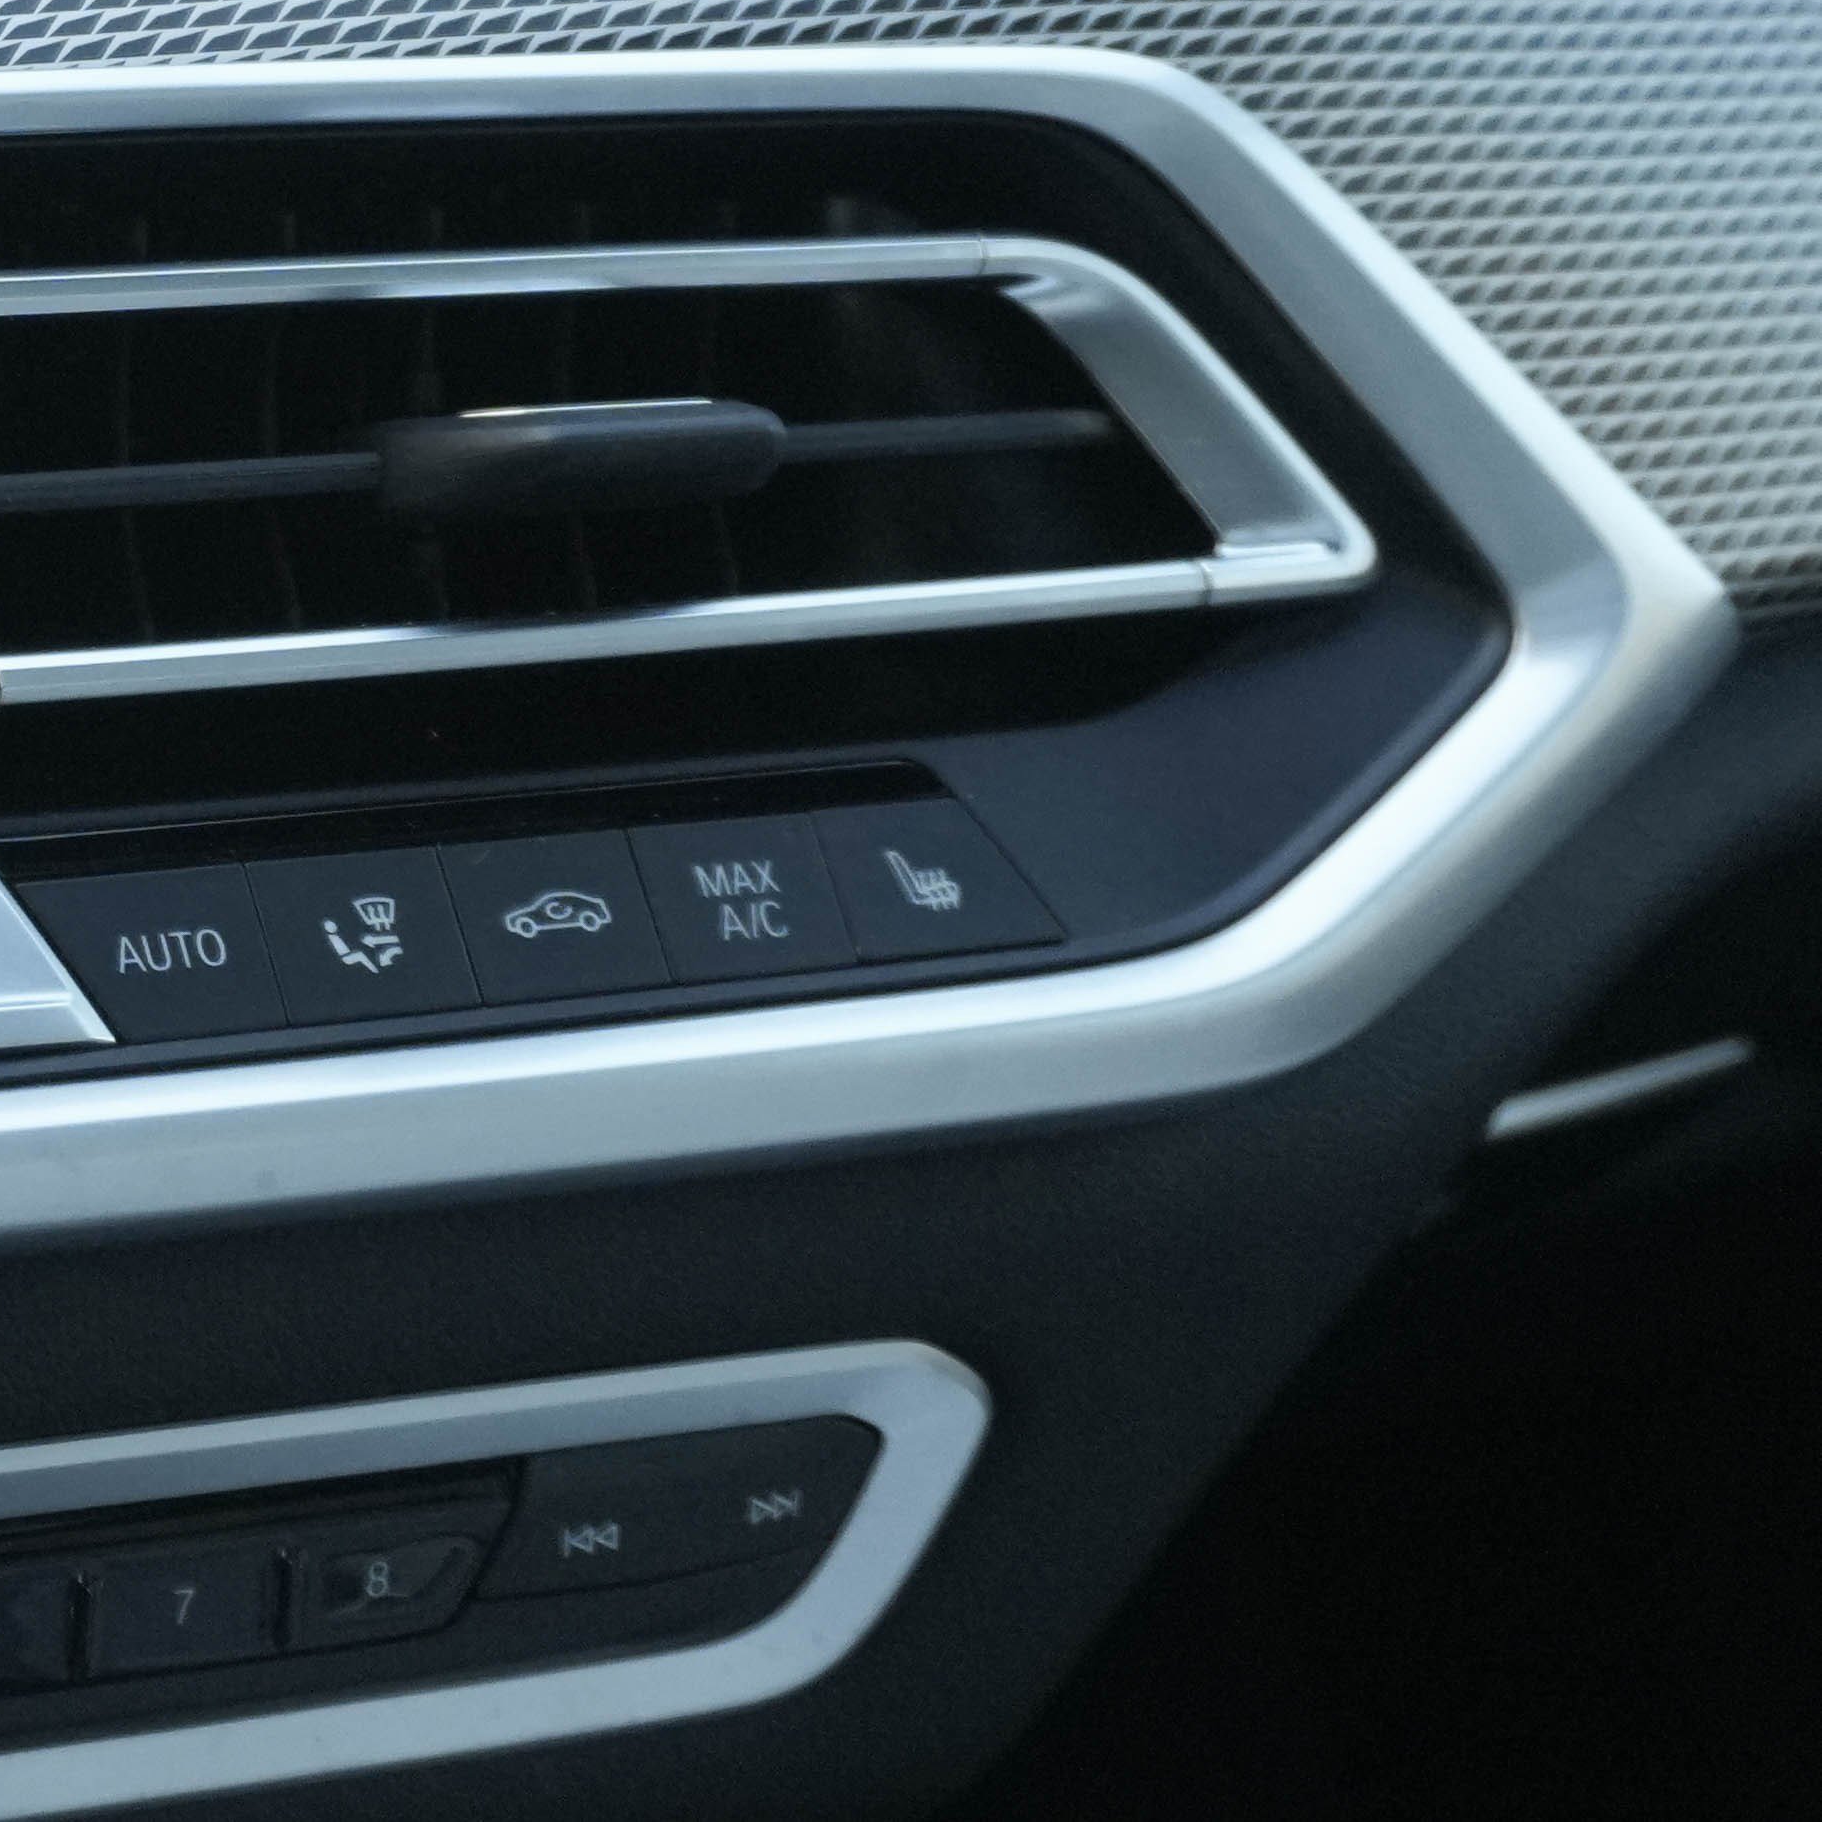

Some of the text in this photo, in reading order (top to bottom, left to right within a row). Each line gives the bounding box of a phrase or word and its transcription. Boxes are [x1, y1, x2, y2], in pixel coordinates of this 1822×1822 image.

[693, 860, 782, 898] MAX
[720, 899, 789, 942] A/C
[116, 928, 228, 975] AUTO
[365, 1560, 390, 1598] 8
[174, 1587, 198, 1625] 7
